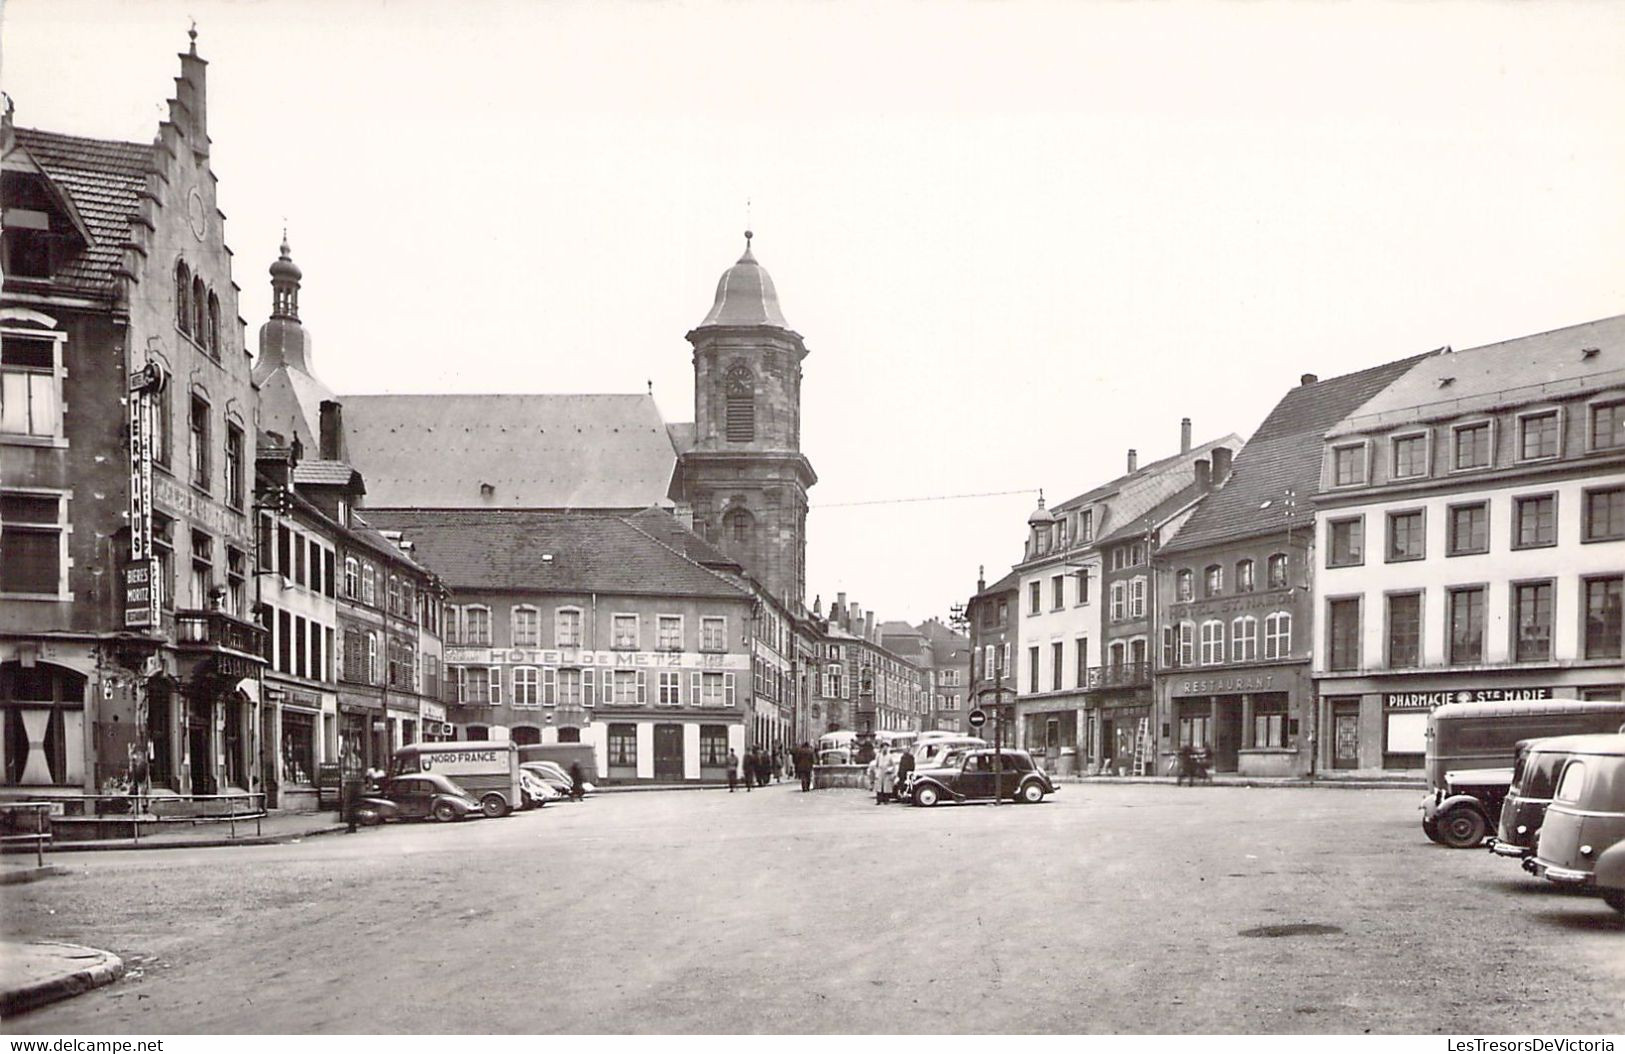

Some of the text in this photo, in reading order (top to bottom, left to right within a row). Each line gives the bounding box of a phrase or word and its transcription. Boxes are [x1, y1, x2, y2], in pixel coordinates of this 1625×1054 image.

[132, 399, 141, 553] TERMINUS
[583, 655, 608, 665] DE
[617, 654, 681, 666] METZ
[1184, 676, 1273, 693] RESTAURANT
[1389, 692, 1454, 707] PHARMACIE
[430, 752, 496, 764] NORD FRANCE
